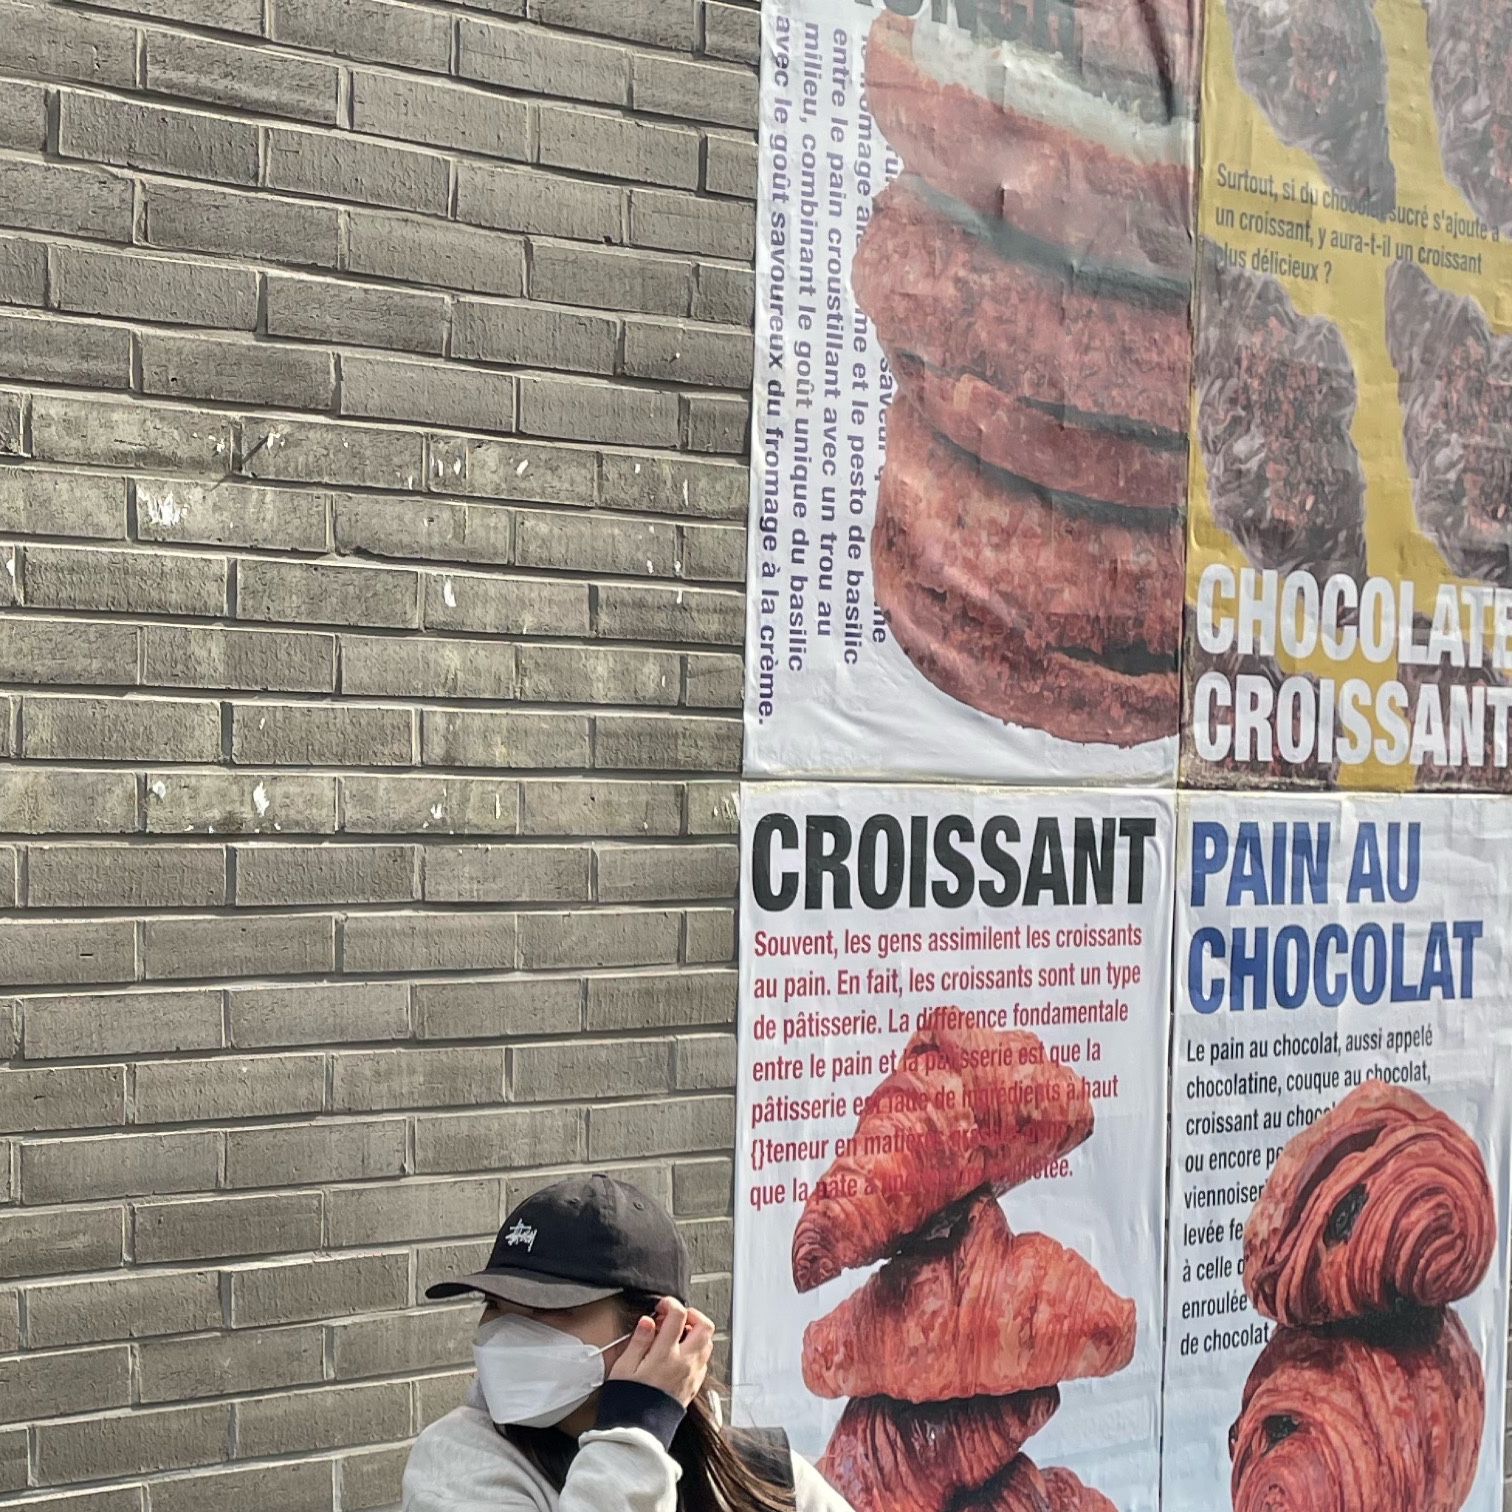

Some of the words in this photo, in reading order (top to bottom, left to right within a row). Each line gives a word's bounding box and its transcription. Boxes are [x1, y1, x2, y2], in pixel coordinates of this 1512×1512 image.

[774, 15, 792, 86] avec
[831, 28, 849, 106] entre
[800, 22, 822, 123] milieu,
[774, 98, 792, 124] le
[830, 117, 848, 142] le
[768, 134, 791, 201] goût
[826, 152, 846, 216] pain
[798, 134, 820, 296] combinant
[1217, 163, 1278, 203] Surtout,
[1283, 179, 1295, 200] si
[1301, 182, 1318, 206] du
[1389, 205, 1428, 228] sucré
[1433, 210, 1487, 240] s'ajoute
[1216, 207, 1234, 228] un
[1240, 211, 1314, 248] croissant,
[1318, 226, 1326, 250] y
[1331, 230, 1391, 257] aura-t-il
[1396, 242, 1413, 261] un
[1418, 246, 1482, 275] croissant
[1252, 248, 1318, 282] délicieux
[1324, 261, 1332, 284] ?
[767, 211, 788, 368] savoureux
[798, 305, 817, 330] le
[824, 228, 846, 398] croustillant
[792, 341, 814, 408] goût
[852, 363, 868, 391] et
[767, 380, 785, 416] du
[852, 400, 868, 425] le
[822, 407, 838, 476] avec
[760, 427, 784, 551] fromage
[788, 418, 811, 518] unique
[847, 434, 868, 514] pesto
[821, 487, 837, 520] un
[790, 528, 809, 564] du
[818, 532, 838, 590] trou
[848, 526, 866, 559] de
[761, 562, 780, 578] à
[760, 590, 780, 614] la
[788, 575, 808, 670] basilic
[817, 601, 833, 636] au
[844, 570, 864, 664] basilic
[758, 625, 778, 724] crème.
[1193, 671, 1512, 768] CROISSANT
[752, 813, 1156, 911] CROISSANT
[1190, 821, 1331, 907] PAIN
[1347, 822, 1421, 903] AU
[754, 930, 838, 959] Souvent,
[844, 928, 871, 953] les
[878, 928, 922, 958] gens
[928, 925, 1021, 952] assimilent
[1027, 924, 1050, 949] les
[1056, 923, 1142, 948] croissants
[754, 977, 777, 999] au
[785, 972, 830, 1002] pain.
[838, 970, 860, 995] En
[867, 967, 903, 997] fait,
[909, 967, 935, 991] les
[941, 965, 1033, 991] croissants
[1038, 964, 1075, 987] sont
[1081, 966, 1101, 986] un
[1106, 962, 1141, 989] type
[1188, 920, 1484, 1014] CHOCOLAT
[753, 1015, 776, 1040] de
[783, 1009, 882, 1043] pâtisserie.
[889, 1010, 909, 1033] La
[917, 1006, 1007, 1032] différence
[1014, 999, 1128, 1028] fondamentale
[752, 1056, 803, 1082] entre
[810, 1054, 826, 1079] le
[832, 1052, 872, 1081] pain
[879, 1050, 897, 1073] et
[903, 1048, 918, 1072] la
[1019, 1040, 1044, 1064] est
[1050, 1045, 1081, 1067] que
[1087, 1038, 1101, 1061] la
[1187, 1038, 1205, 1063] Le
[1210, 1037, 1245, 1066] pain
[1250, 1039, 1269, 1059] au
[1274, 1031, 1341, 1059] chocolat,
[1345, 1028, 1382, 1053] aussi
[1387, 1023, 1433, 1054] appelé
[1187, 1072, 1282, 1099] chocolatine,
[1287, 1069, 1339, 1095] couque
[1345, 1066, 1362, 1087] au
[1367, 1060, 1431, 1085] chocolat,
[751, 1091, 847, 1128] pâtisserie
[935, 1085, 956, 1110] de
[1082, 1075, 1118, 1099] haut
[1186, 1109, 1259, 1136] croissant
[1263, 1111, 1281, 1130] au
[835, 1137, 856, 1158] en
[1185, 1155, 1203, 1173] ou
[1209, 1148, 1261, 1170] encore
[750, 1184, 785, 1211] que
[793, 1178, 808, 1203] la
[816, 1173, 858, 1204] pâte
[1184, 1179, 1268, 1209] viennoiser
[1184, 1220, 1224, 1246] levée
[1183, 1259, 1191, 1282] à
[1197, 1256, 1232, 1281] celle
[1182, 1289, 1248, 1319] enroulée
[1181, 1333, 1199, 1356] de
